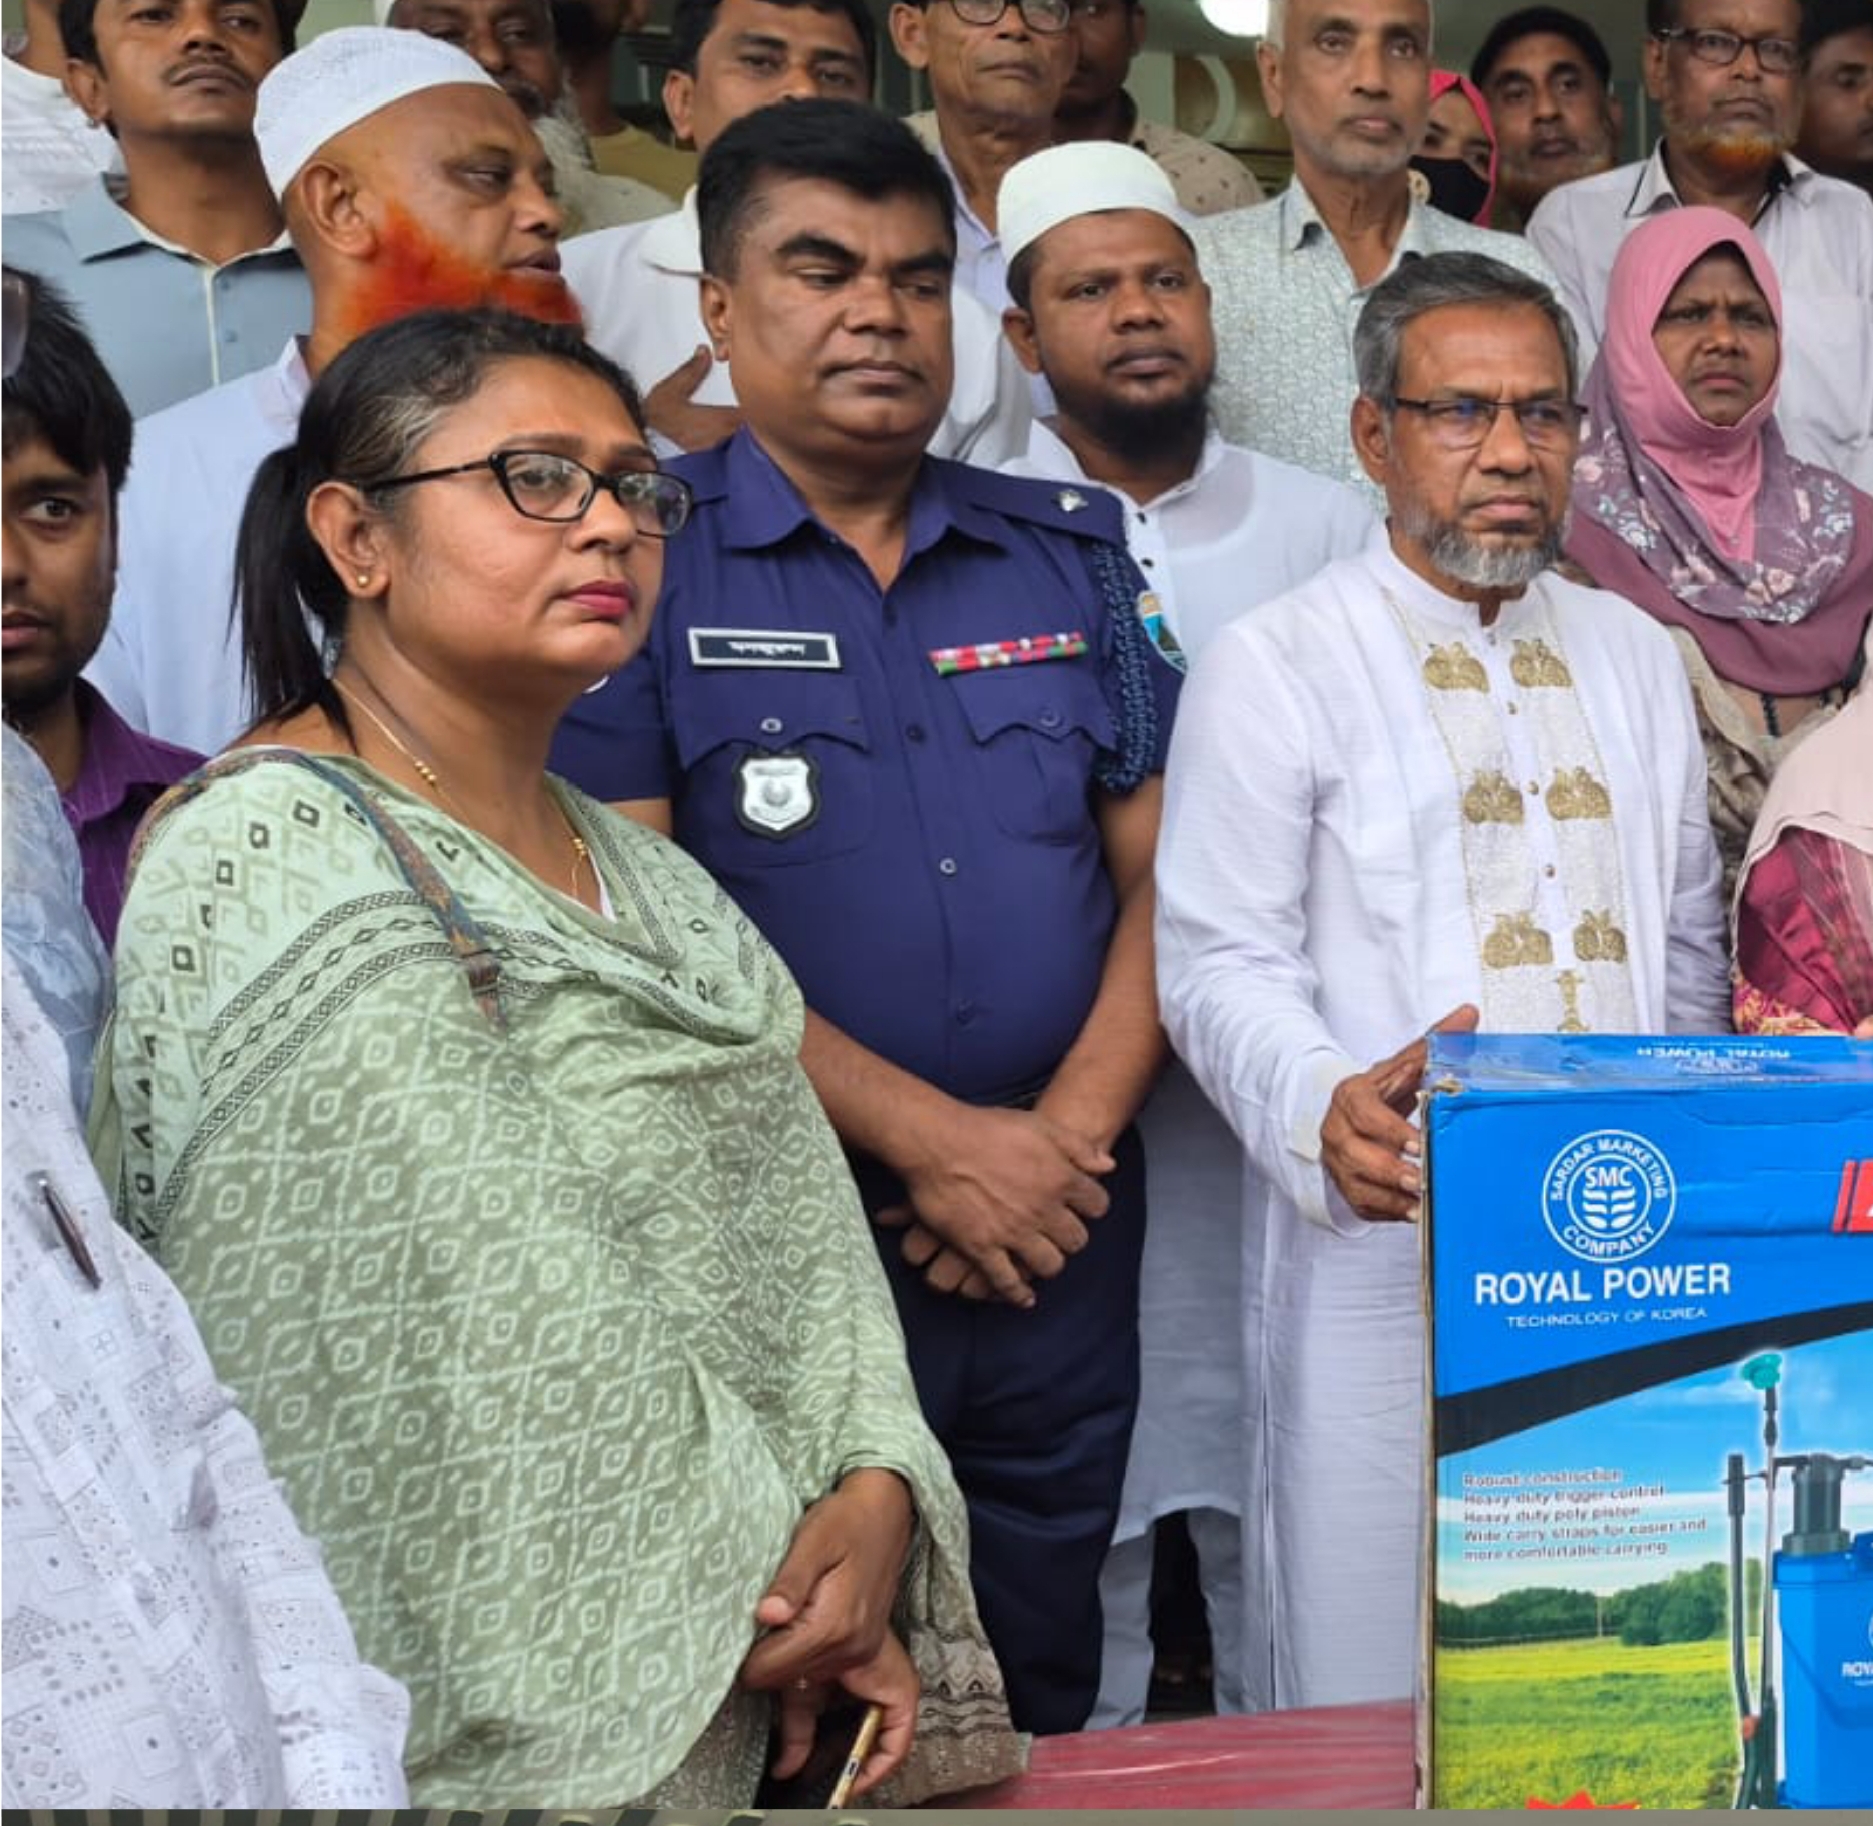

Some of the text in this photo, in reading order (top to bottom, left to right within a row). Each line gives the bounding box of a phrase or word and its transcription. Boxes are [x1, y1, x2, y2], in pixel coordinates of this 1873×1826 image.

[1551, 1138, 1668, 1200] SARDAR MARKETING
[1585, 1166, 1632, 1188] SMC
[1563, 1220, 1654, 1256] COMPANY
[1475, 1262, 1731, 1305] ROYAL POWER
[1507, 1307, 1708, 1328] TECHNOLOGY OF KOREA
[1464, 1469, 1622, 1487] Robust construction
[1464, 1485, 1664, 1507] Heavy duty trigger control
[1464, 1505, 1639, 1524] Heavy duty poly piston
[1464, 1518, 1706, 1543] Wide carry straps for easier and
[1464, 1540, 1668, 1561] more comfortable carrying
